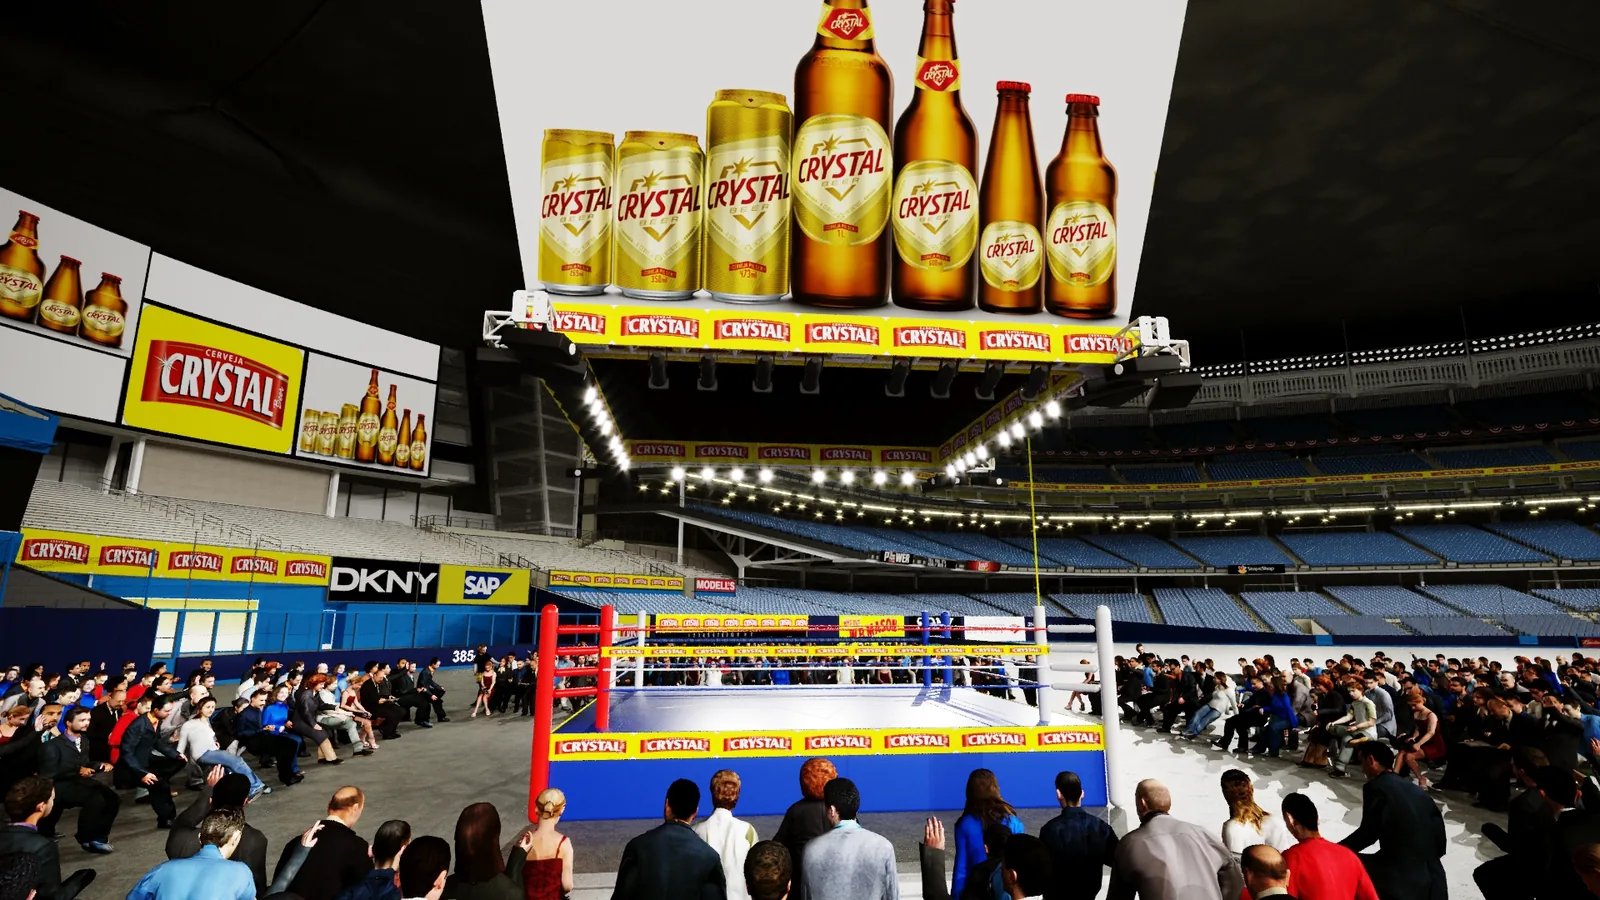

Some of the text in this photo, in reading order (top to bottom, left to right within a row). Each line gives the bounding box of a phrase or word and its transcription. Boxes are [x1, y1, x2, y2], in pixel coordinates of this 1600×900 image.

[830, 17, 864, 30] CRYSTAL
[923, 69, 954, 81] CRYSTAL
[798, 148, 885, 184] CRYSTAL
[707, 172, 790, 210] CRYSTAL
[540, 185, 612, 219] CRYSTAL
[616, 184, 701, 222] CRYSTAL
[899, 189, 971, 219] CRYSTAL
[1052, 221, 1108, 245] CRYSTAL
[986, 239, 1035, 259] CRYSTAL
[0, 275, 38, 291] YSTAL
[44, 305, 76, 317] CRYSTAL
[86, 311, 121, 324] CRYSTAL
[628, 318, 693, 336] CRYSTAL
[720, 321, 785, 340] CRYSTAL
[812, 325, 874, 343] CRYSTAL
[900, 329, 961, 346] CRYSTAL
[986, 333, 1046, 350] CRYSTAL
[205, 349, 244, 366] CERVEJA
[160, 352, 274, 418] CRYSTAL
[273, 386, 285, 410] Beer
[636, 444, 681, 456] CRYSTAL
[700, 446, 744, 457] CRYSTAL
[763, 447, 806, 459] CRYSTAL
[825, 449, 869, 460] CRYSTAL
[886, 450, 928, 461] CRYSTAL
[29, 543, 84, 561] CRYSTAL
[173, 554, 219, 570] CRYSTAL
[235, 558, 275, 573] CRYSTAL
[289, 562, 324, 576] CRYSTAL
[329, 566, 439, 594] DKNY
[464, 575, 501, 595] SAP
[696, 579, 736, 591] MODELL'S
[646, 739, 705, 751] CRYSTAL
[729, 737, 788, 750] CRYSTAL
[811, 736, 867, 748] CRYSTAL
[890, 735, 947, 747] CRYSTAL
[967, 734, 1023, 745] CRYSTAL
[1043, 732, 1096, 744] CRYSTAL
[561, 740, 622, 753] CRYSTAL
